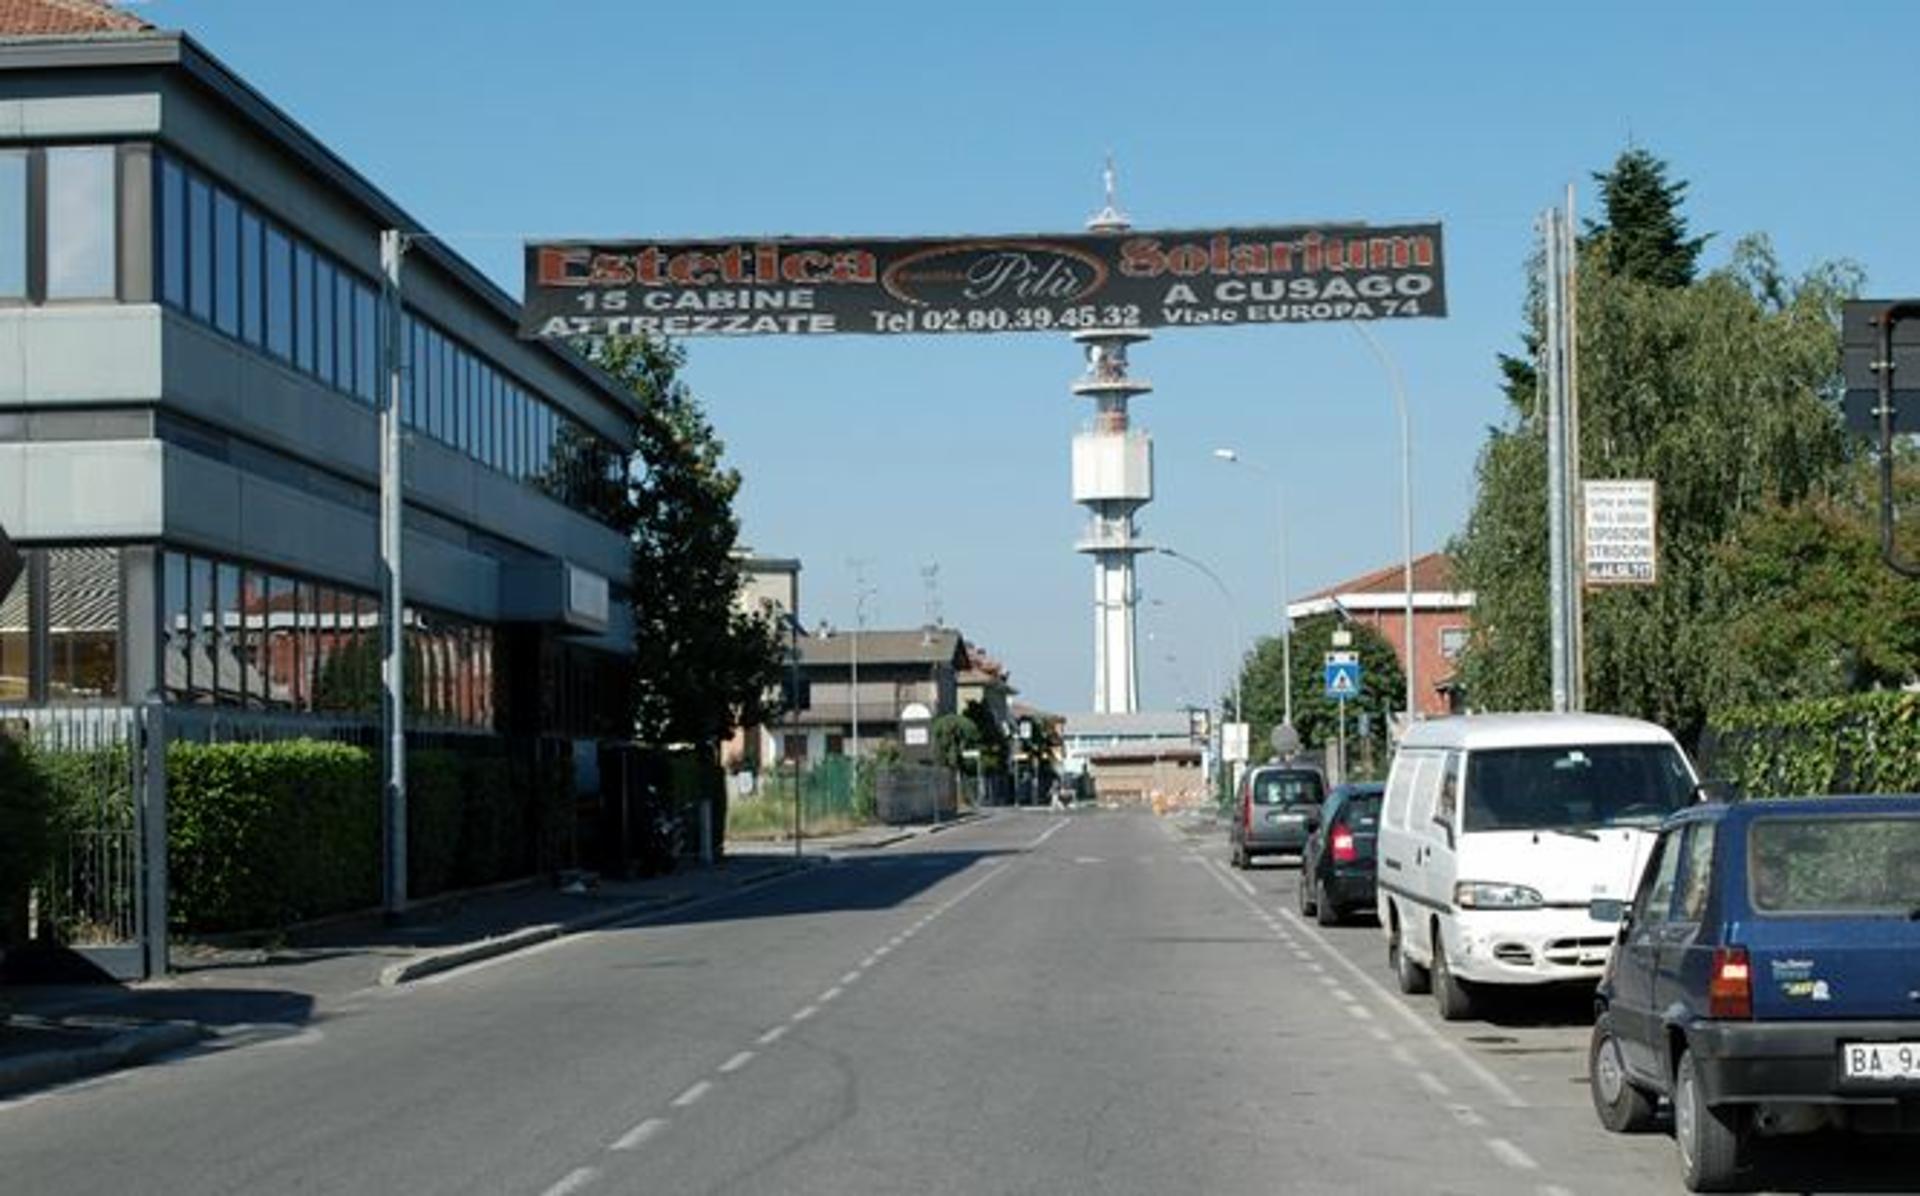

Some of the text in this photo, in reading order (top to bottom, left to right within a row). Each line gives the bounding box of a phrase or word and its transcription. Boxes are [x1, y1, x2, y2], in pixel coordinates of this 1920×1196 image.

[1118, 229, 1434, 277] Solarium
[538, 245, 878, 287] Estetica
[576, 288, 815, 311] 15 CABINE
[1164, 273, 1433, 304] A CUSAGO
[871, 310, 915, 332] Tel
[1247, 301, 1374, 321] EUROPA
[1380, 298, 1420, 316] 74
[538, 313, 836, 336] ATTREZZATE
